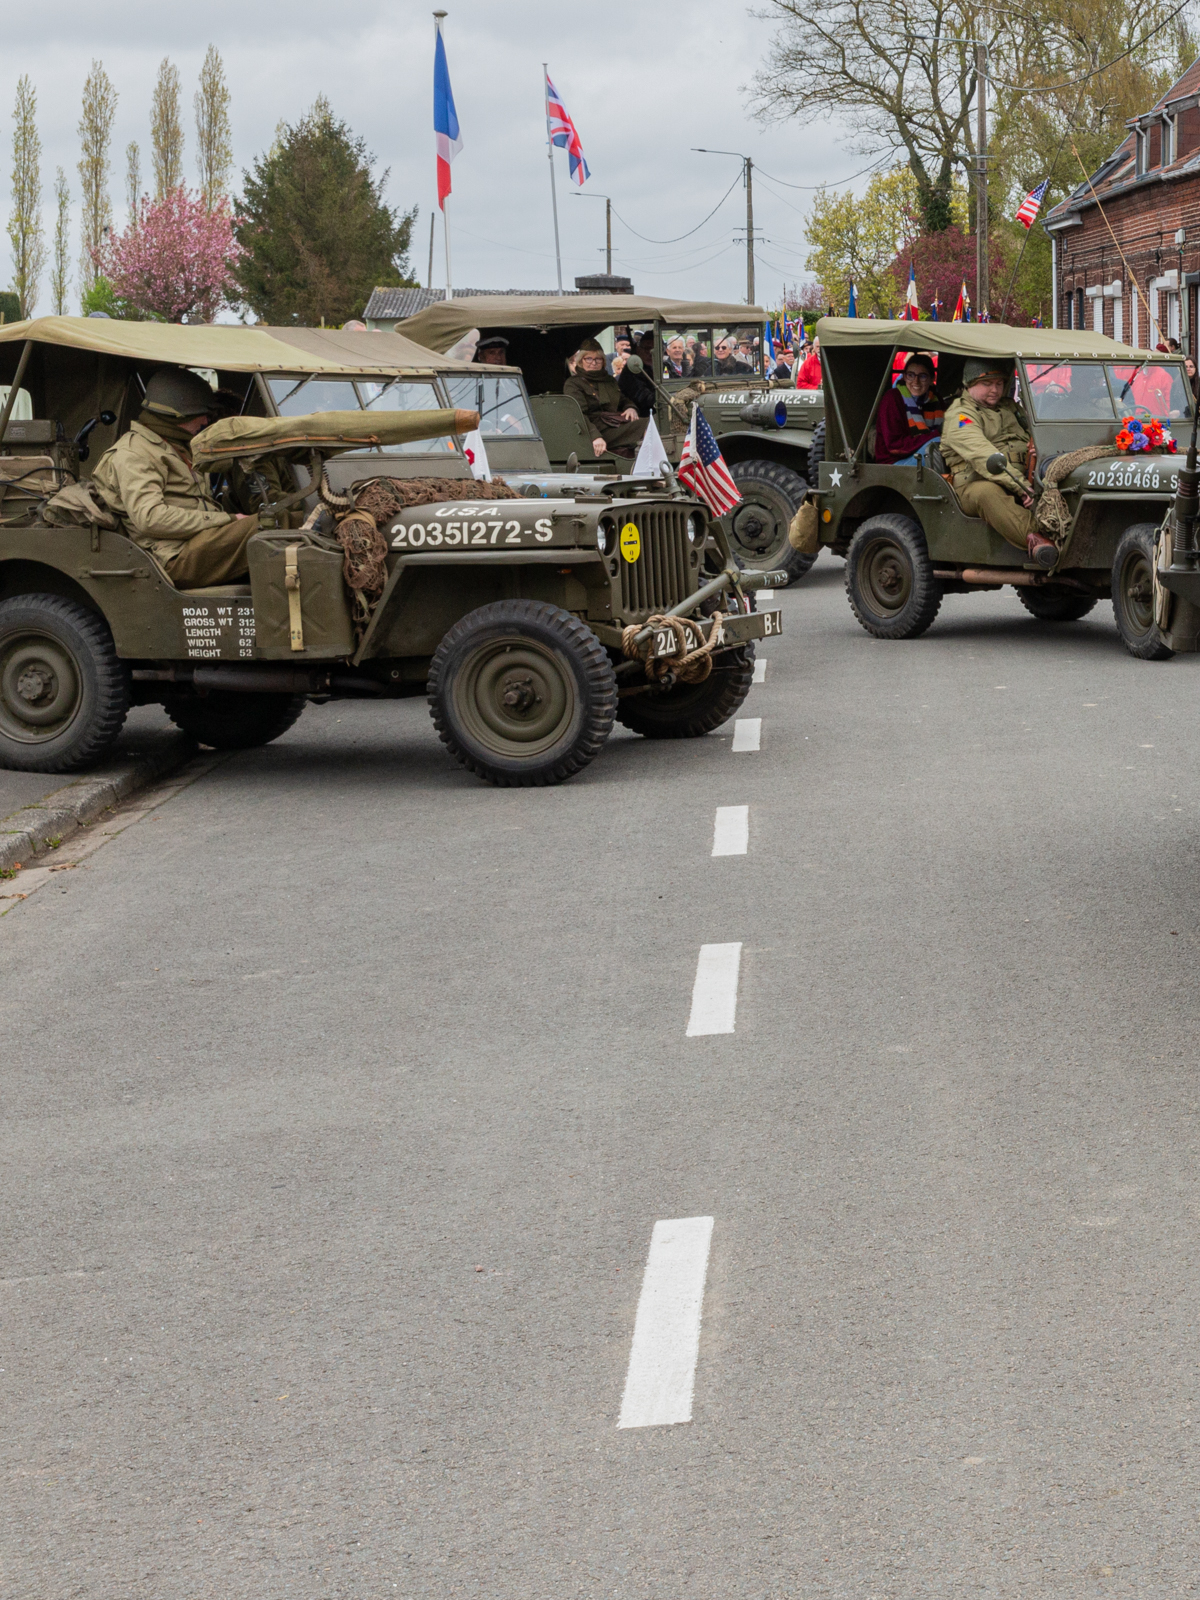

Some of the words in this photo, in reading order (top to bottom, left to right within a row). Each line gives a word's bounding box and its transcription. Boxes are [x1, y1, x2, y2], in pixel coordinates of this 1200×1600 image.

[718, 394, 747, 404] U.S.A.
[435, 506, 502, 517] U.S.A.
[182, 607, 209, 616] ROAD
[217, 607, 233, 616] WT
[184, 617, 215, 627] GROSS
[218, 617, 234, 627] WT
[185, 628, 221, 637] LENGTH
[187, 639, 216, 647] WIDTH
[238, 639, 252, 647] 62
[188, 649, 222, 657] HEIGHT
[239, 649, 253, 657] 52
